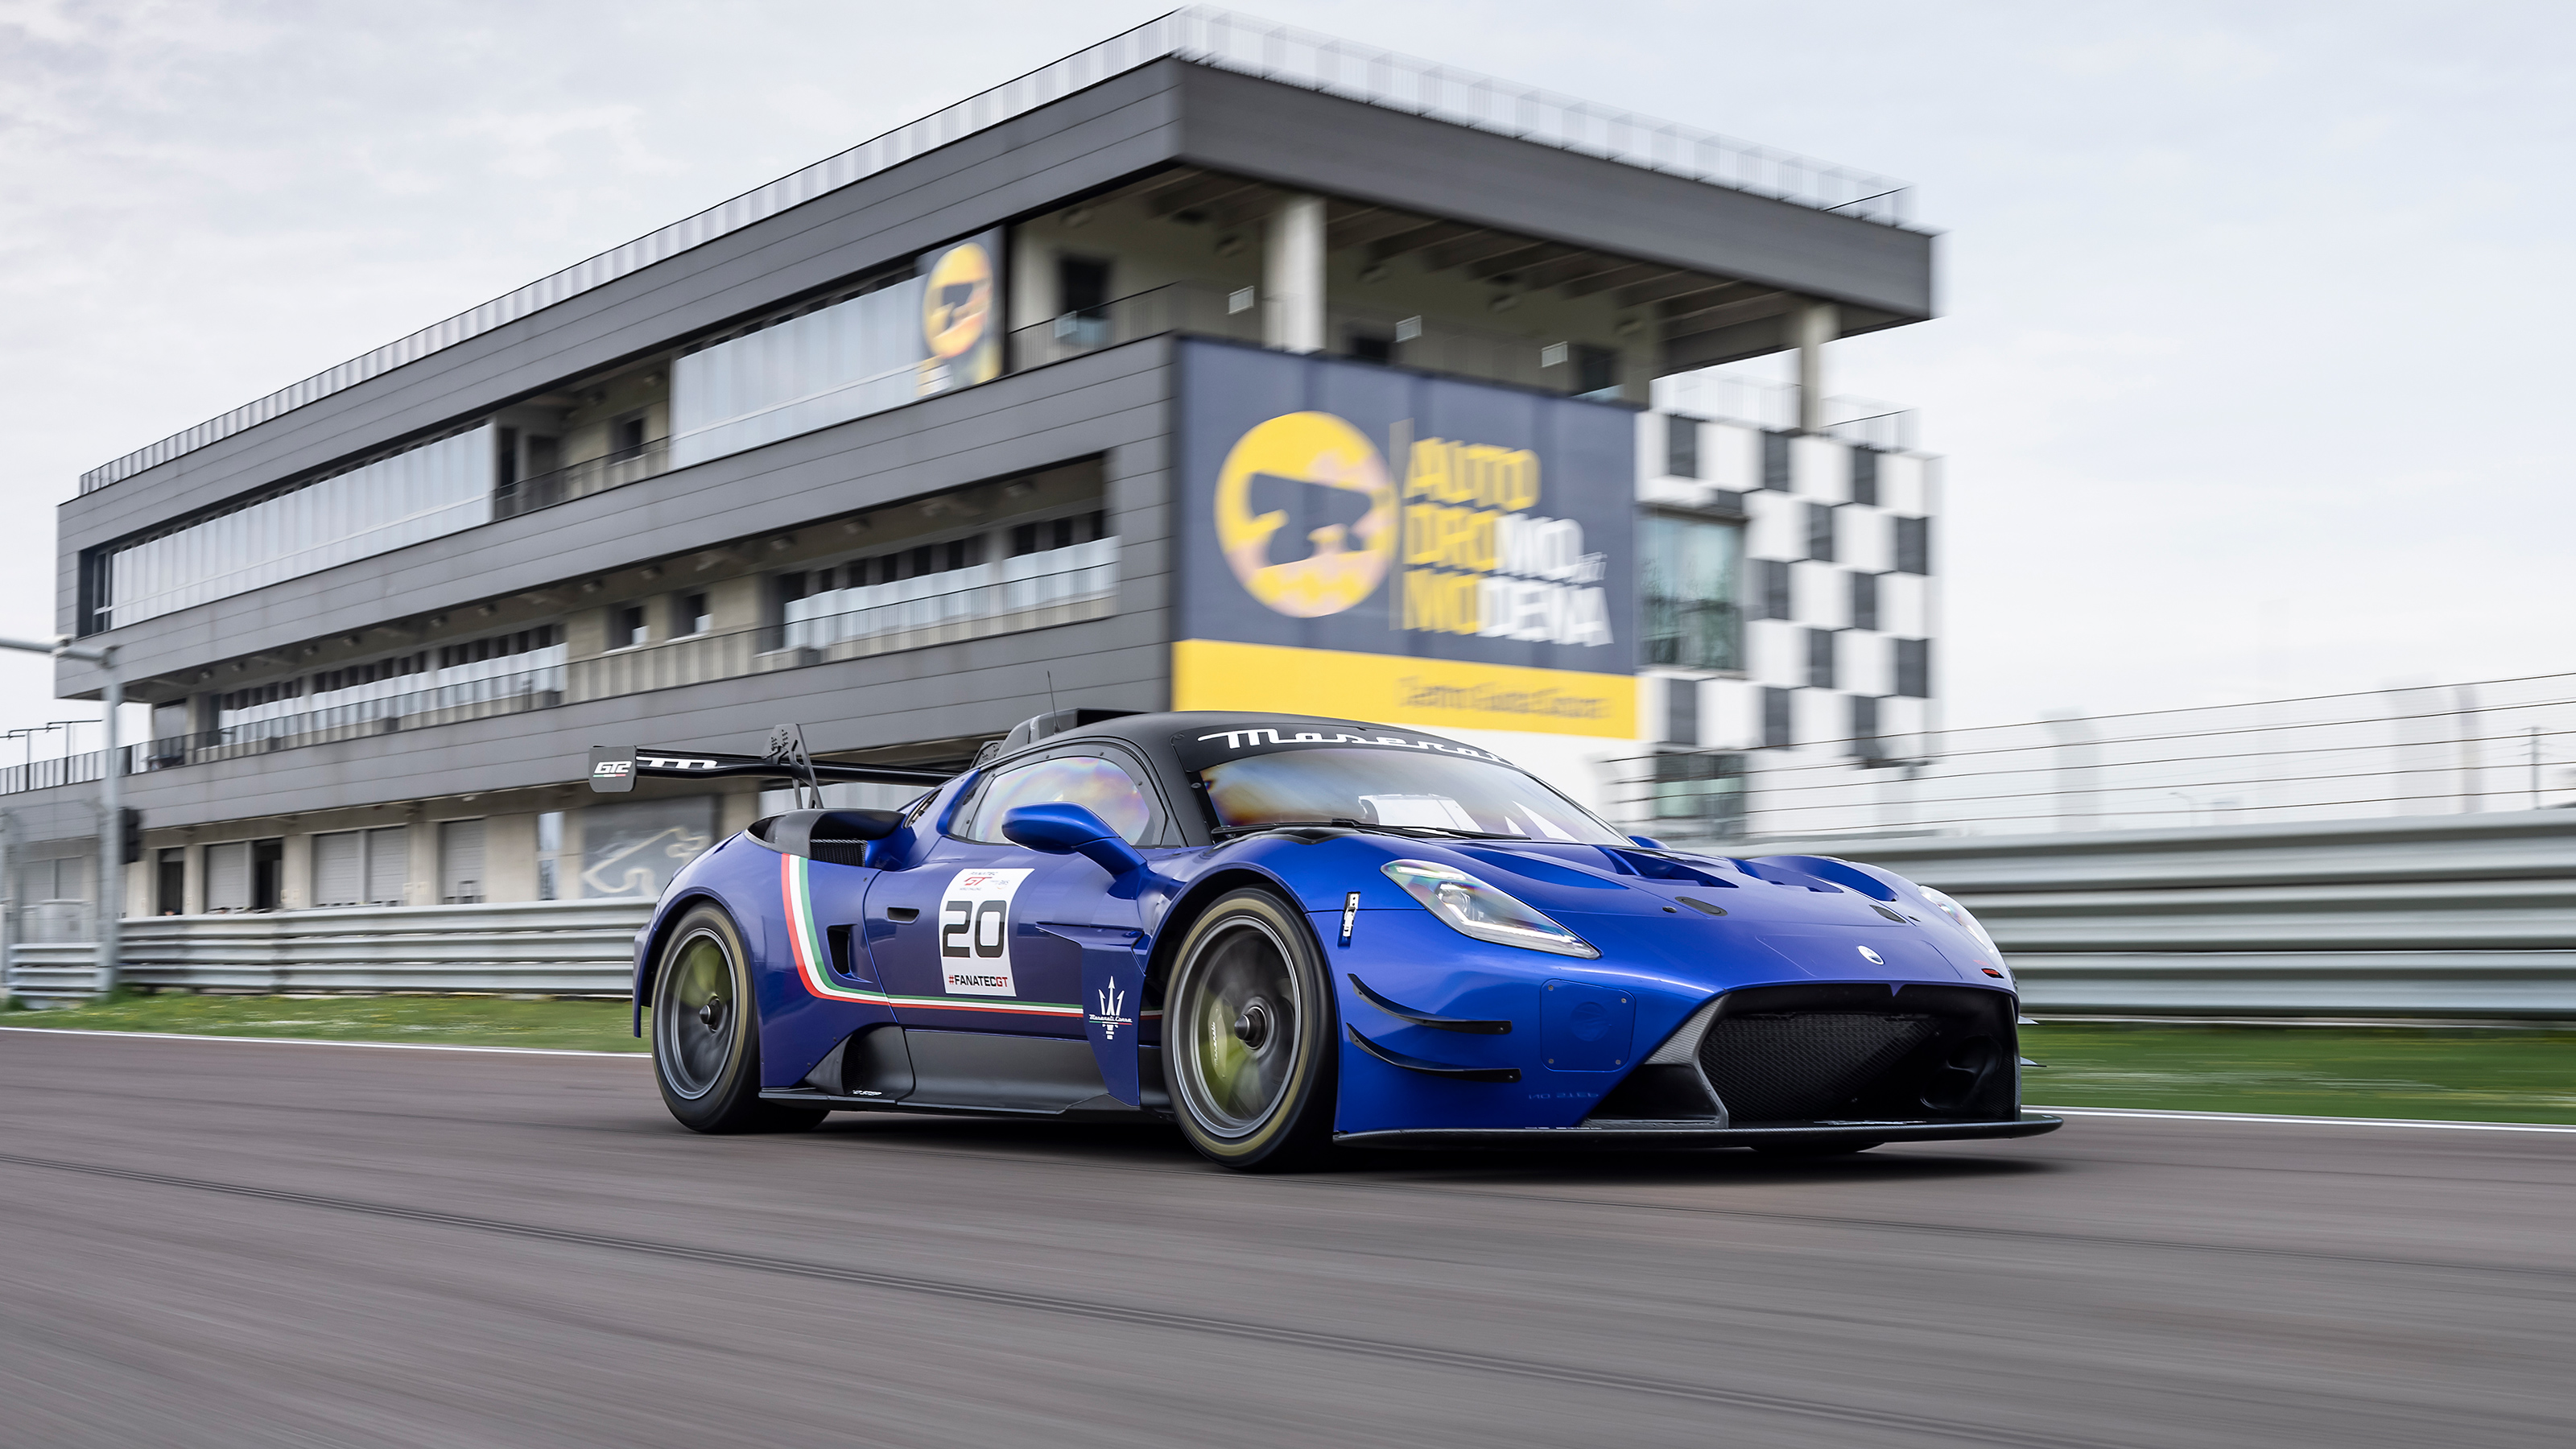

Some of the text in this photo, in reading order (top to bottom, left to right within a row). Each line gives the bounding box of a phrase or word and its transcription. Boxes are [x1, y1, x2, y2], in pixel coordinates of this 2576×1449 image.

[1403, 437, 1541, 511] AUTO
[1403, 568, 1613, 646] MODENA
[594, 761, 632, 774] GT2
[943, 900, 1006, 958] 20
[948, 975, 1008, 988] #FANATECGT
